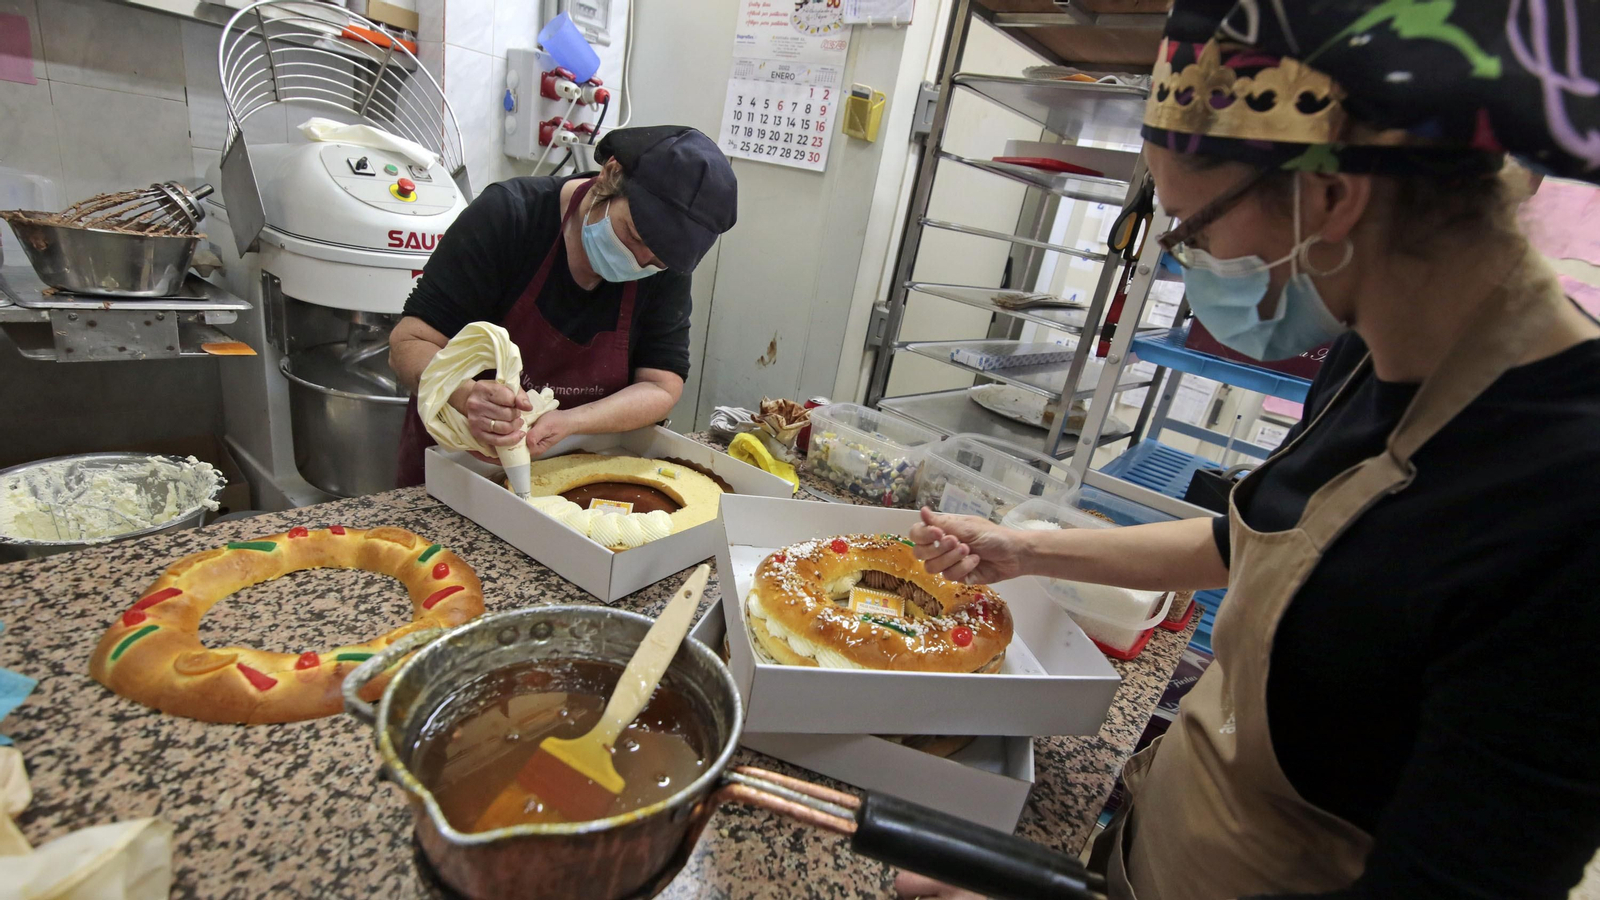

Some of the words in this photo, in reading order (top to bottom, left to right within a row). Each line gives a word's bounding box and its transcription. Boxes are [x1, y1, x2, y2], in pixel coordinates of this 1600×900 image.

[771, 71, 796, 81] ENERO
[810, 88, 814, 99] 1
[823, 89, 830, 100] 2
[737, 96, 743, 106] 3
[750, 97, 756, 108] 4
[764, 99, 770, 109] 5
[777, 101, 784, 111] 6
[792, 102, 798, 113] 7
[805, 103, 812, 115] 8
[820, 105, 827, 116] 9
[733, 110, 742, 121] 10
[747, 112, 754, 122] 11
[760, 113, 769, 125] 12
[773, 115, 782, 126] 13
[786, 117, 796, 128] 14
[801, 119, 811, 130] 15
[815, 120, 825, 132] 16
[731, 125, 740, 135] 17
[744, 126, 753, 137] 18
[757, 128, 766, 139] 19
[769, 130, 780, 141] 20
[783, 132, 793, 143] 21
[797, 134, 808, 146] 22
[811, 136, 823, 148] 23
[740, 141, 751, 152] 25
[753, 143, 764, 154] 26
[766, 145, 778, 156] 27
[780, 147, 792, 158] 28
[794, 149, 806, 160] 29
[807, 151, 820, 162] 30
